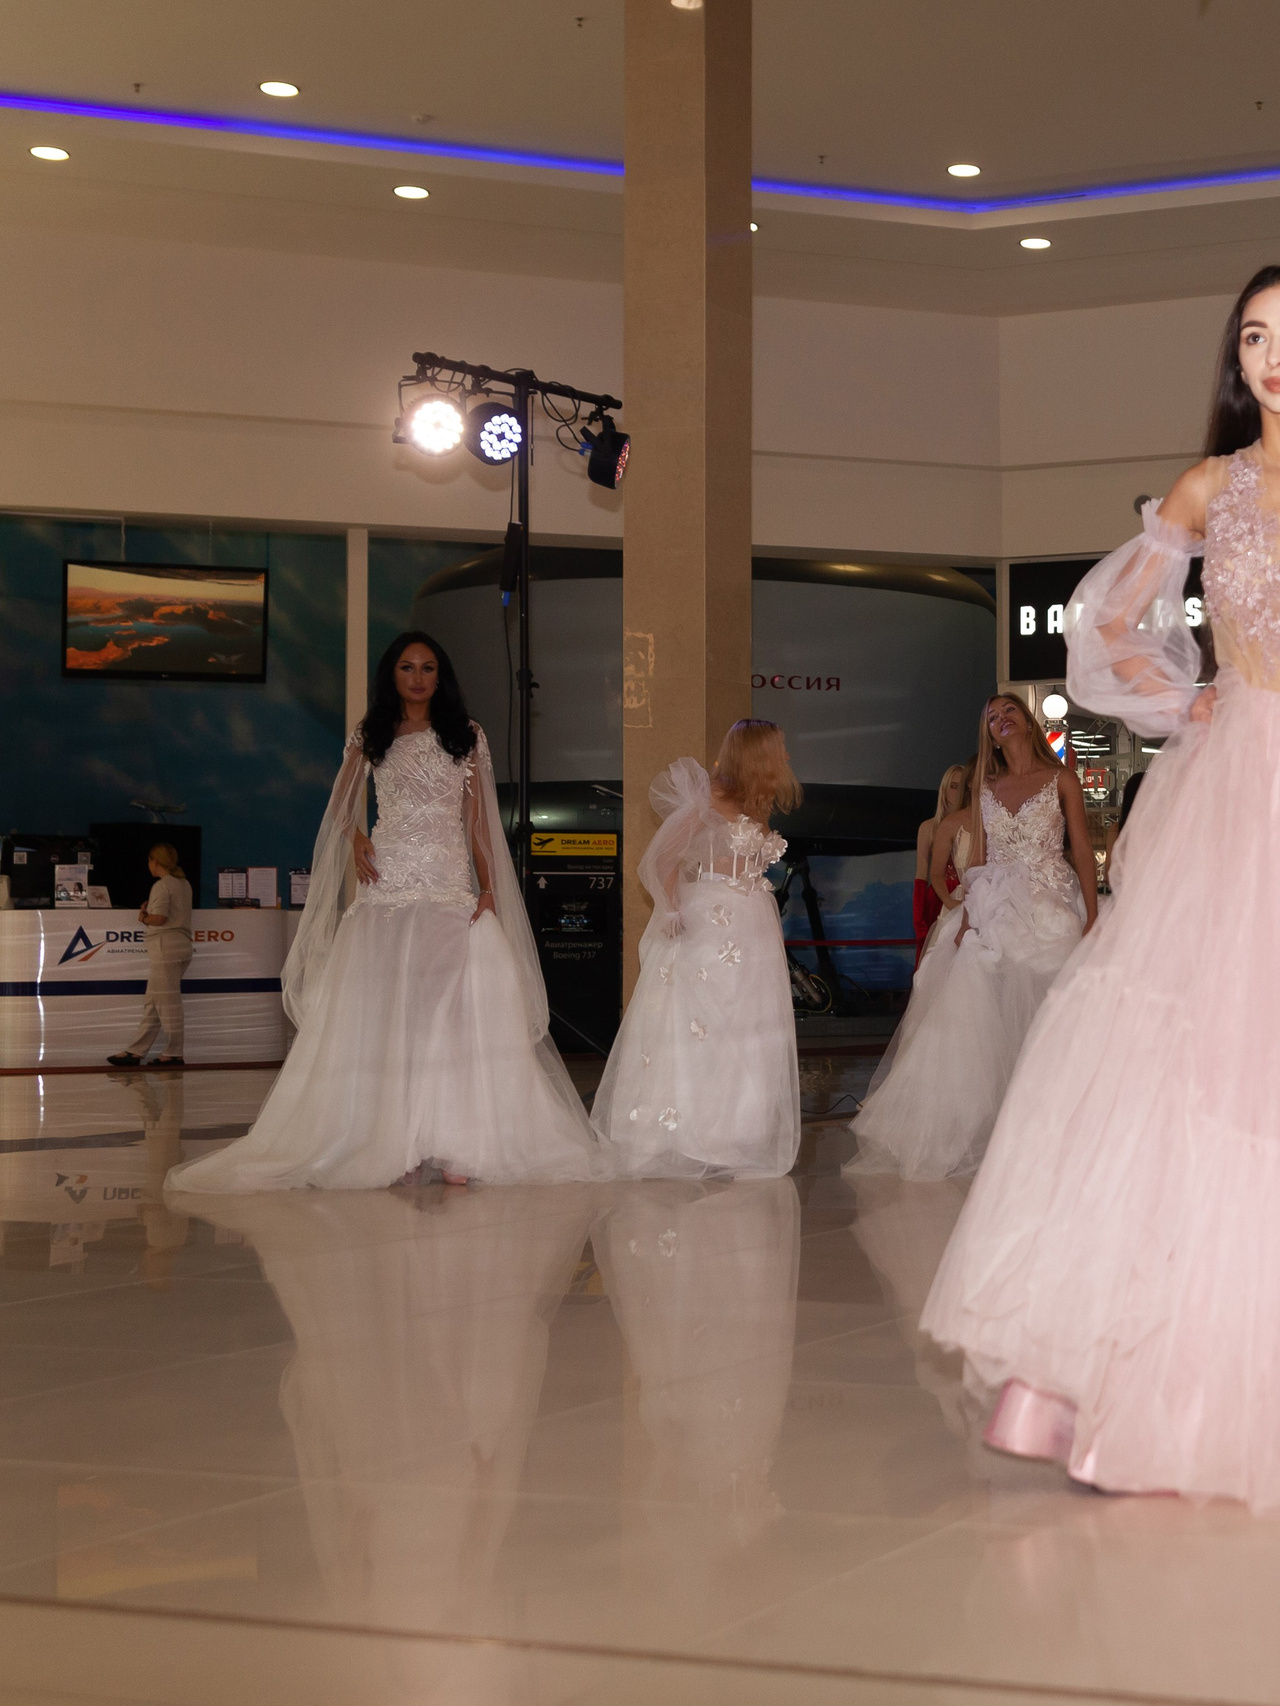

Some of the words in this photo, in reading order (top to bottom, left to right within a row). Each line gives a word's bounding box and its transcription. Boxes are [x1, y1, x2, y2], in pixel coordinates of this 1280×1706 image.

[752, 674, 841, 691] ОССИЯ
[589, 877, 614, 890] 737
[106, 930, 144, 943] DRE
[193, 930, 235, 943] ERO
[553, 951, 580, 960] Boeing
[582, 951, 596, 959] 737
